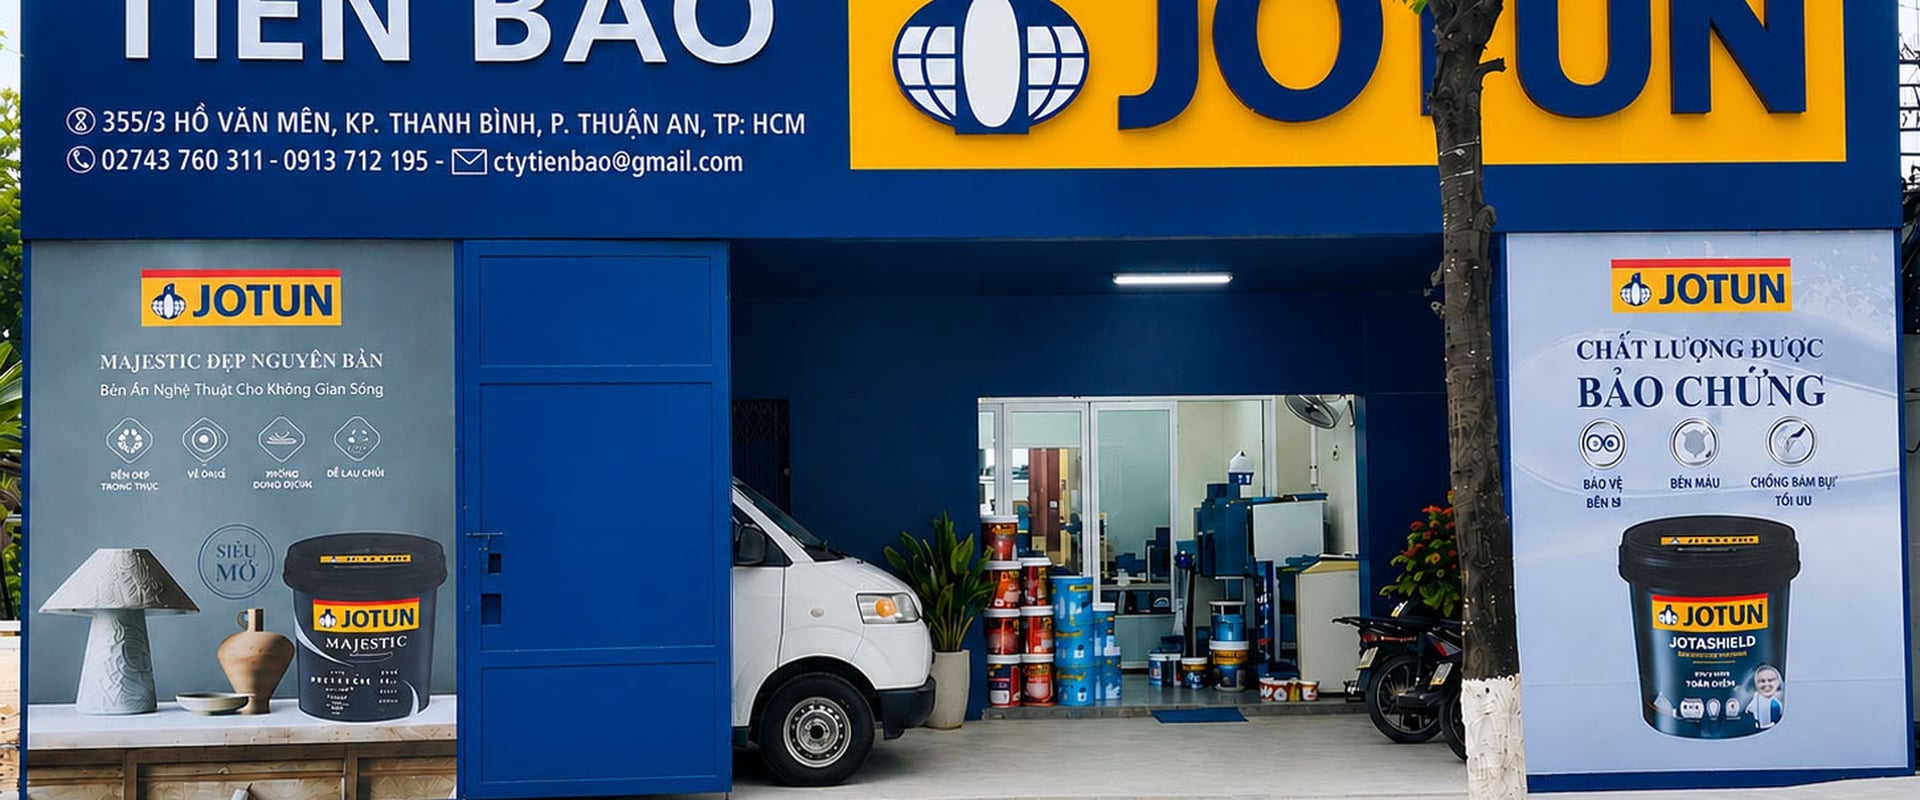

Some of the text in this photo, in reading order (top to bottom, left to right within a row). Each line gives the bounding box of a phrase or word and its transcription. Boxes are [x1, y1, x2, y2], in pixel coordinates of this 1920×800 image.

[1117, 0, 1806, 131] JOUN
[102, 102, 805, 140] 355/3 HỒ VĂN MÊN, KP. THANH BÌNH, P. THUẬN AN, TP: HCM
[101, 148, 170, 171] 02743
[177, 148, 219, 171] 760
[226, 148, 262, 171] 311
[283, 149, 336, 171] 0913
[343, 149, 382, 171] 712
[391, 149, 428, 172] 195
[493, 149, 743, 178] ctytienbao@gmail.com
[192, 284, 333, 318] JOTUN
[1658, 273, 1785, 305] JOTUN
[100, 353, 201, 374] MAJESTIC
[206, 353, 247, 373] ĐẸP
[252, 348, 336, 369] NGUYÊN
[1654, 335, 1744, 364] LƯỢNG
[1751, 335, 1824, 363] ĐƯỢC
[235, 382, 264, 396] Cho
[314, 382, 346, 396] Gian
[1577, 365, 1826, 408] BẢO CHỨNG
[341, 607, 415, 629] JOTUN
[1682, 603, 1764, 627] JOTUN
[325, 635, 408, 655] MAJESTIC
[1669, 635, 1757, 651] JOTASHIELD
